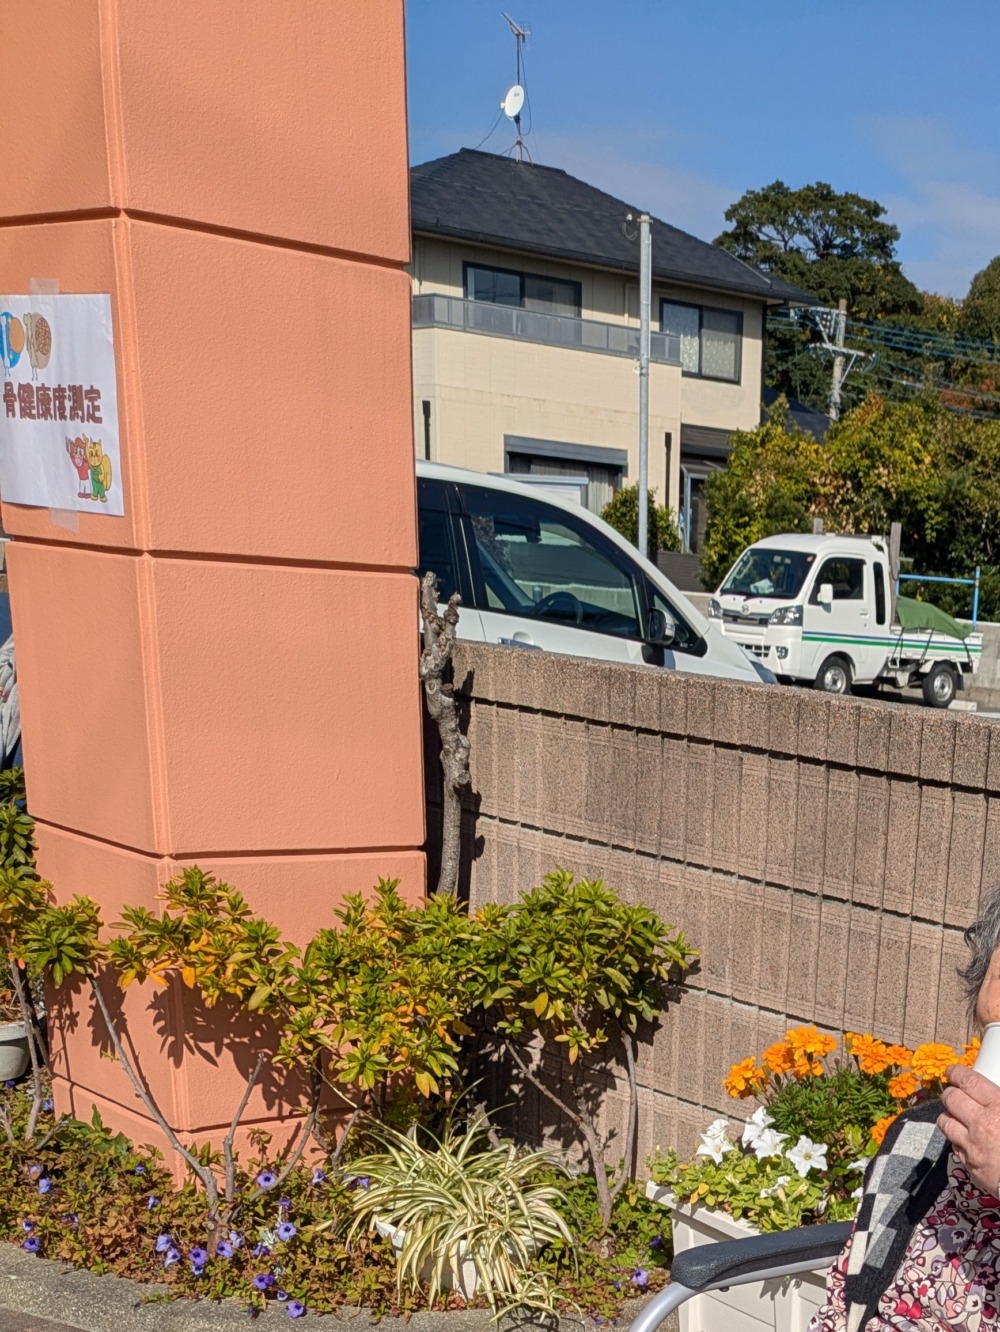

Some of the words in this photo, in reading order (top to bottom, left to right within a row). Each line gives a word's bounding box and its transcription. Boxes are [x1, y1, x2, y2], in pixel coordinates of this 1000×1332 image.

[3, 381, 103, 424] 骨健康度測定
